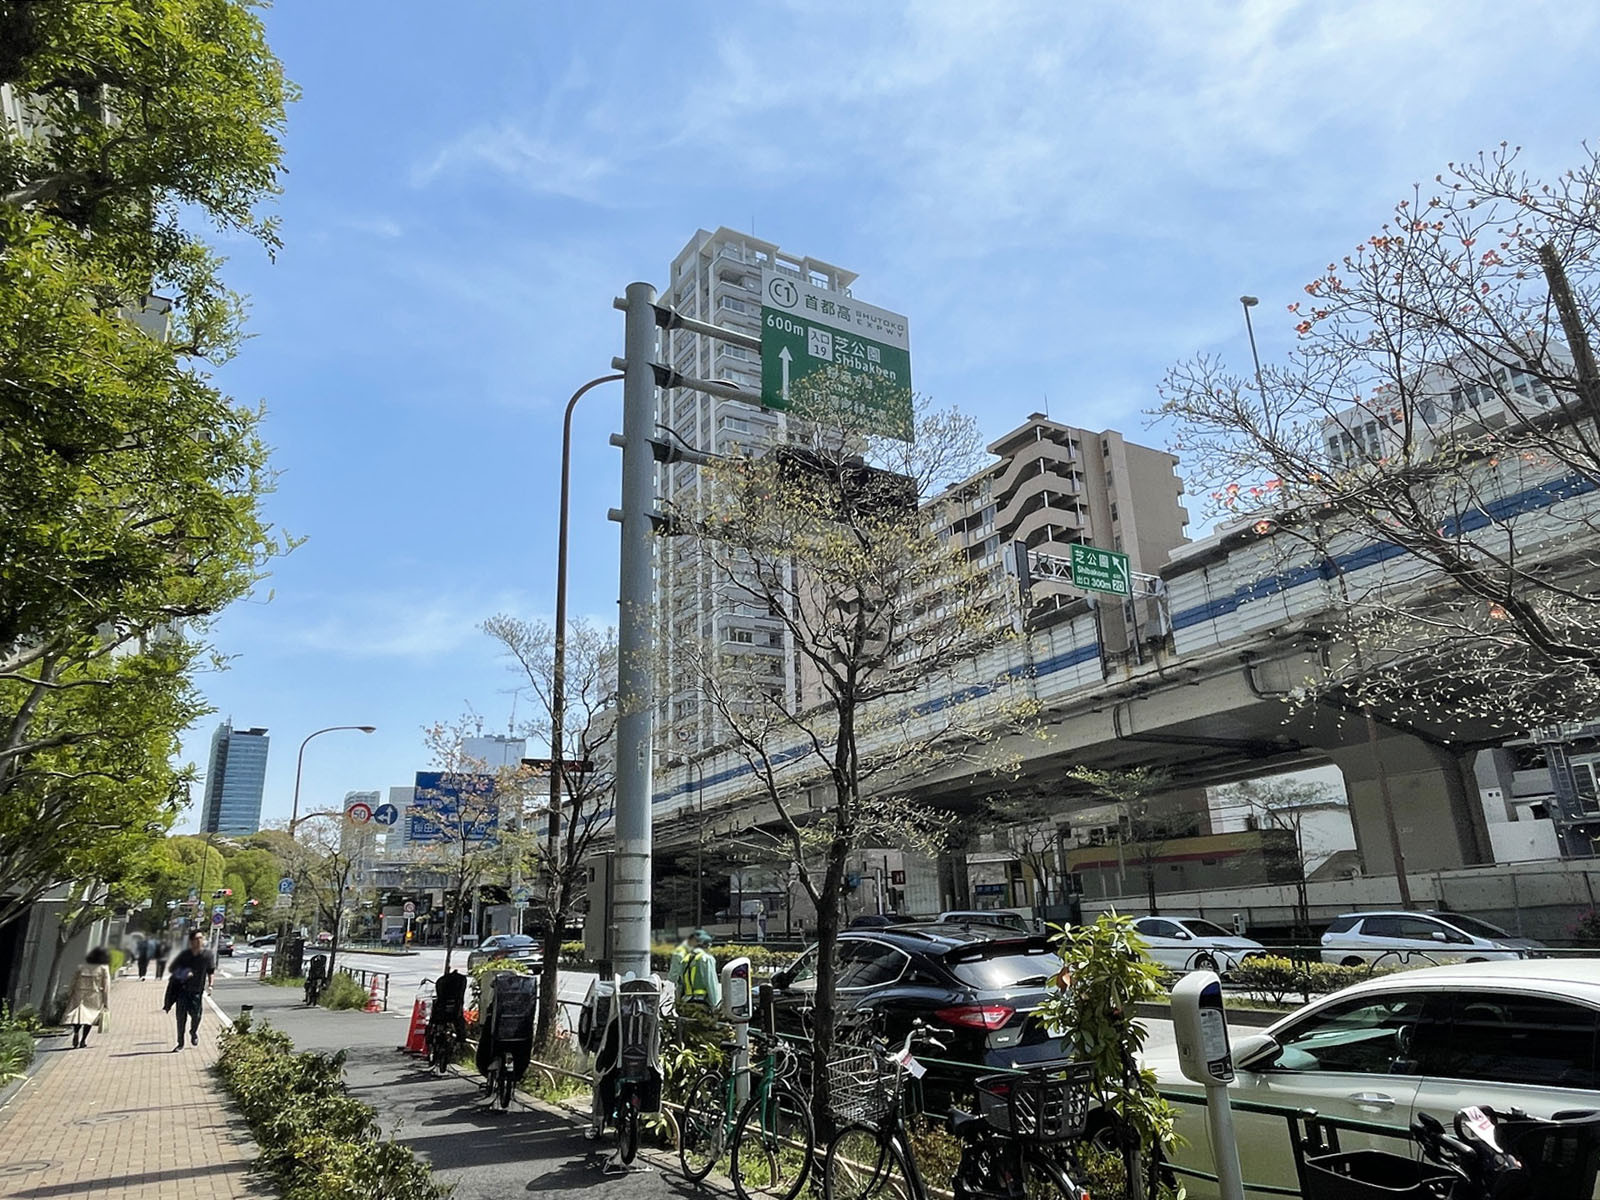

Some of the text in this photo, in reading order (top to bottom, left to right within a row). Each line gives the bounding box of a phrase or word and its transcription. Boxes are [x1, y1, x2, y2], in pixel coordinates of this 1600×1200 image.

[773, 283, 791, 303] C1
[804, 293, 851, 322] 首都高
[766, 314, 804, 337] 600m
[855, 310, 904, 333] SHUTOKO
[810, 330, 830, 345] 入口
[814, 344, 827, 357] 19
[834, 335, 881, 363] 芝公園
[1074, 550, 1109, 569] 芝公園
[1076, 575, 1112, 590] 出口 300m
[1113, 581, 1124, 591] 20
[353, 809, 366, 820] 50
